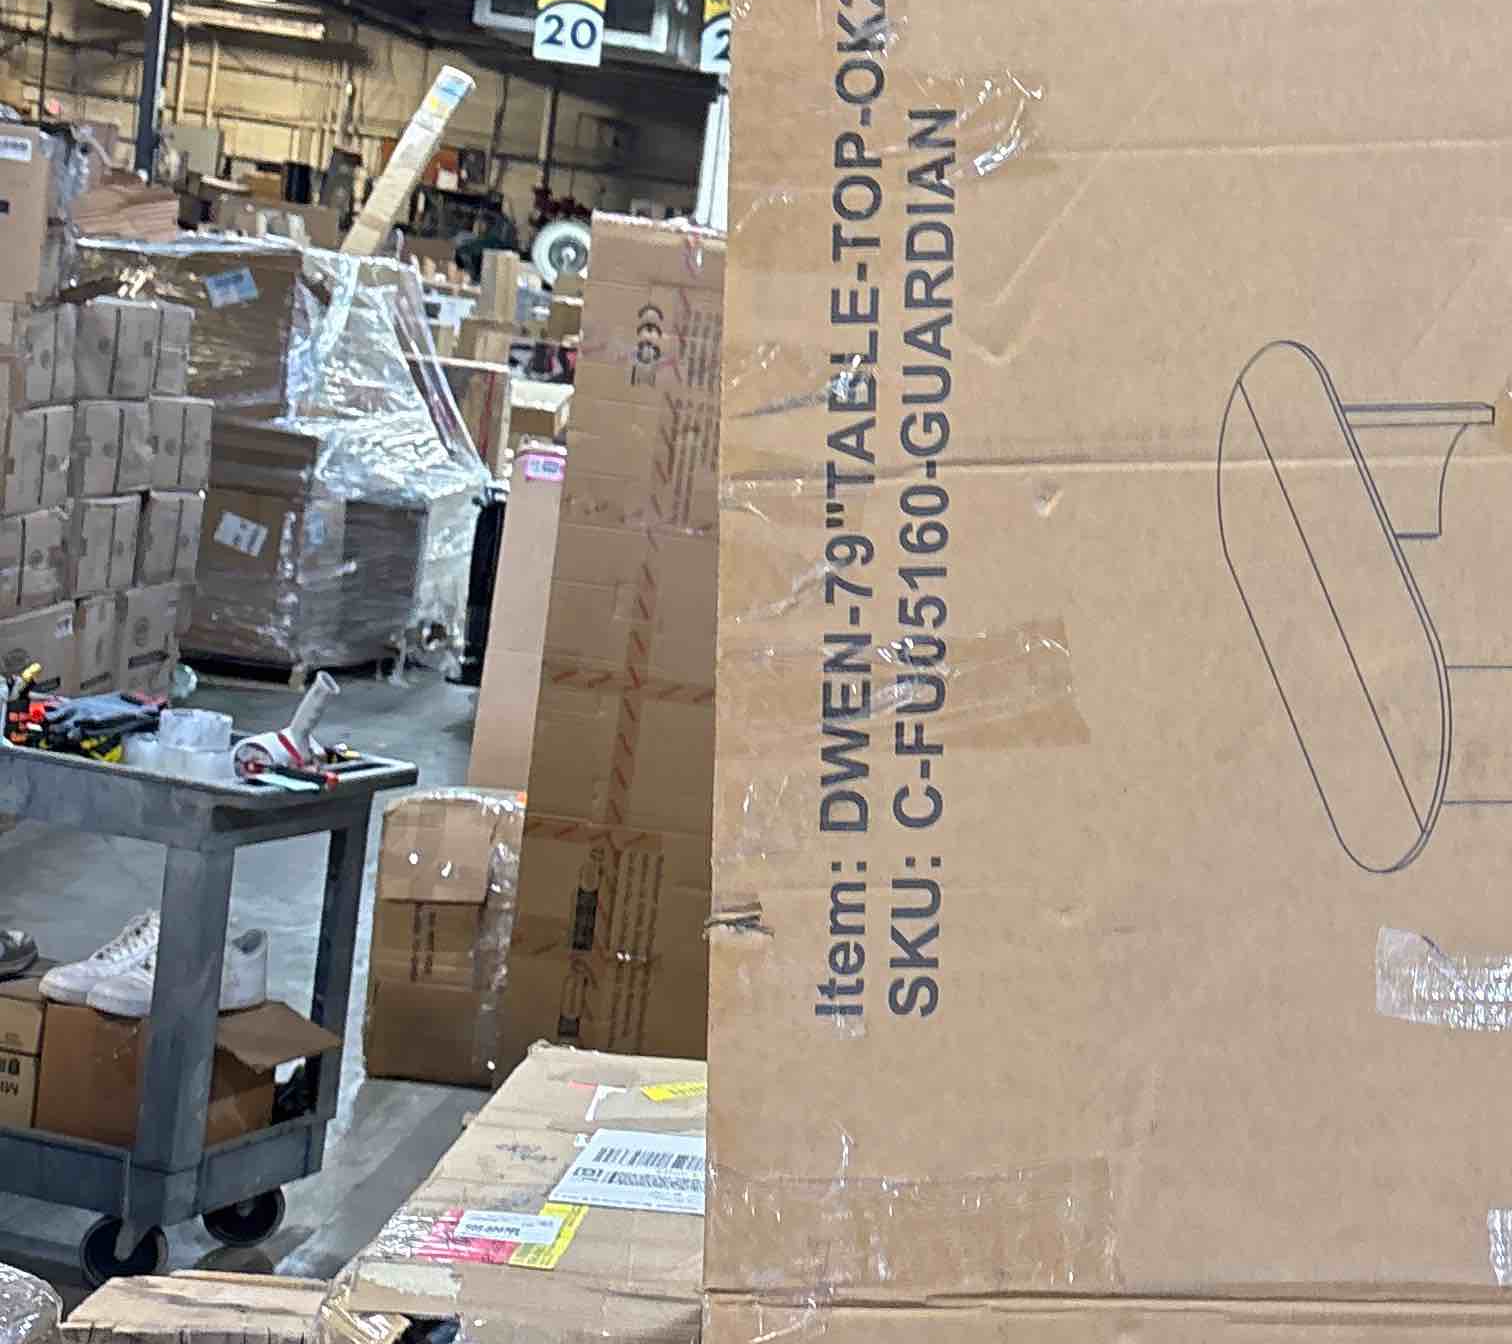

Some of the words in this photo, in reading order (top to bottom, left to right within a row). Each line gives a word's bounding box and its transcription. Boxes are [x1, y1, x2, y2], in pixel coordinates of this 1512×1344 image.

[541, 13, 597, 50] 20
[892, 108, 957, 830] C-FU05160-GUARDIAN
[815, 859, 867, 1017] Item:
[888, 856, 942, 1018] SKU:
